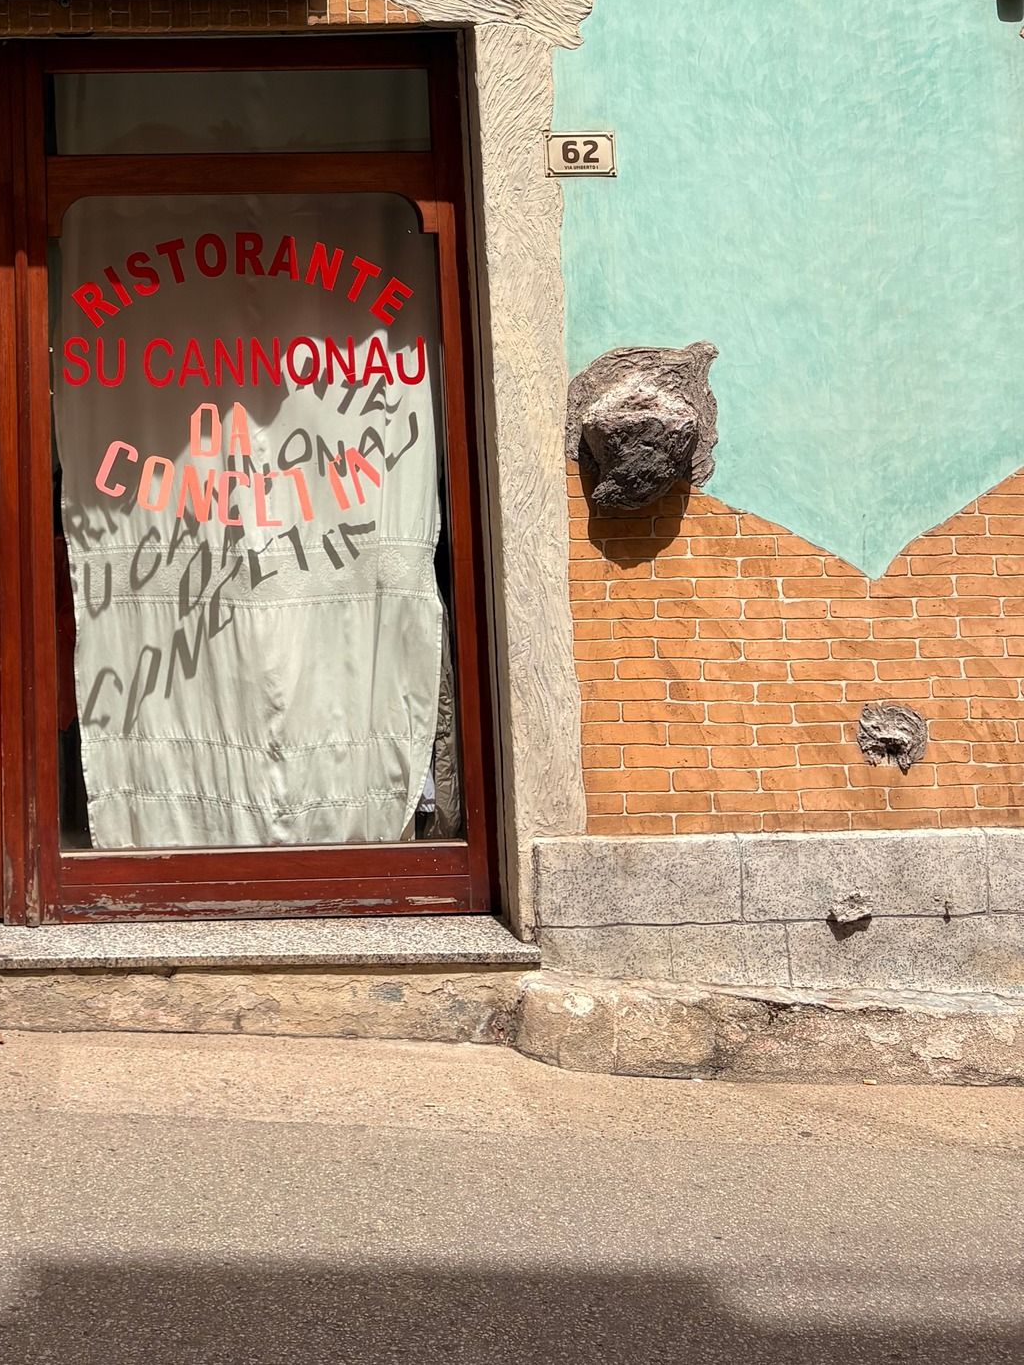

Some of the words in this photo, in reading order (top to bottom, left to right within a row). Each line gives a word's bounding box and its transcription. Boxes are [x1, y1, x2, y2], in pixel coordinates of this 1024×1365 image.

[562, 140, 600, 164] 62
[71, 232, 415, 329] RISTORANTE
[62, 336, 126, 388] SU
[143, 335, 427, 388] CANNONAU
[190, 402, 251, 458] DA
